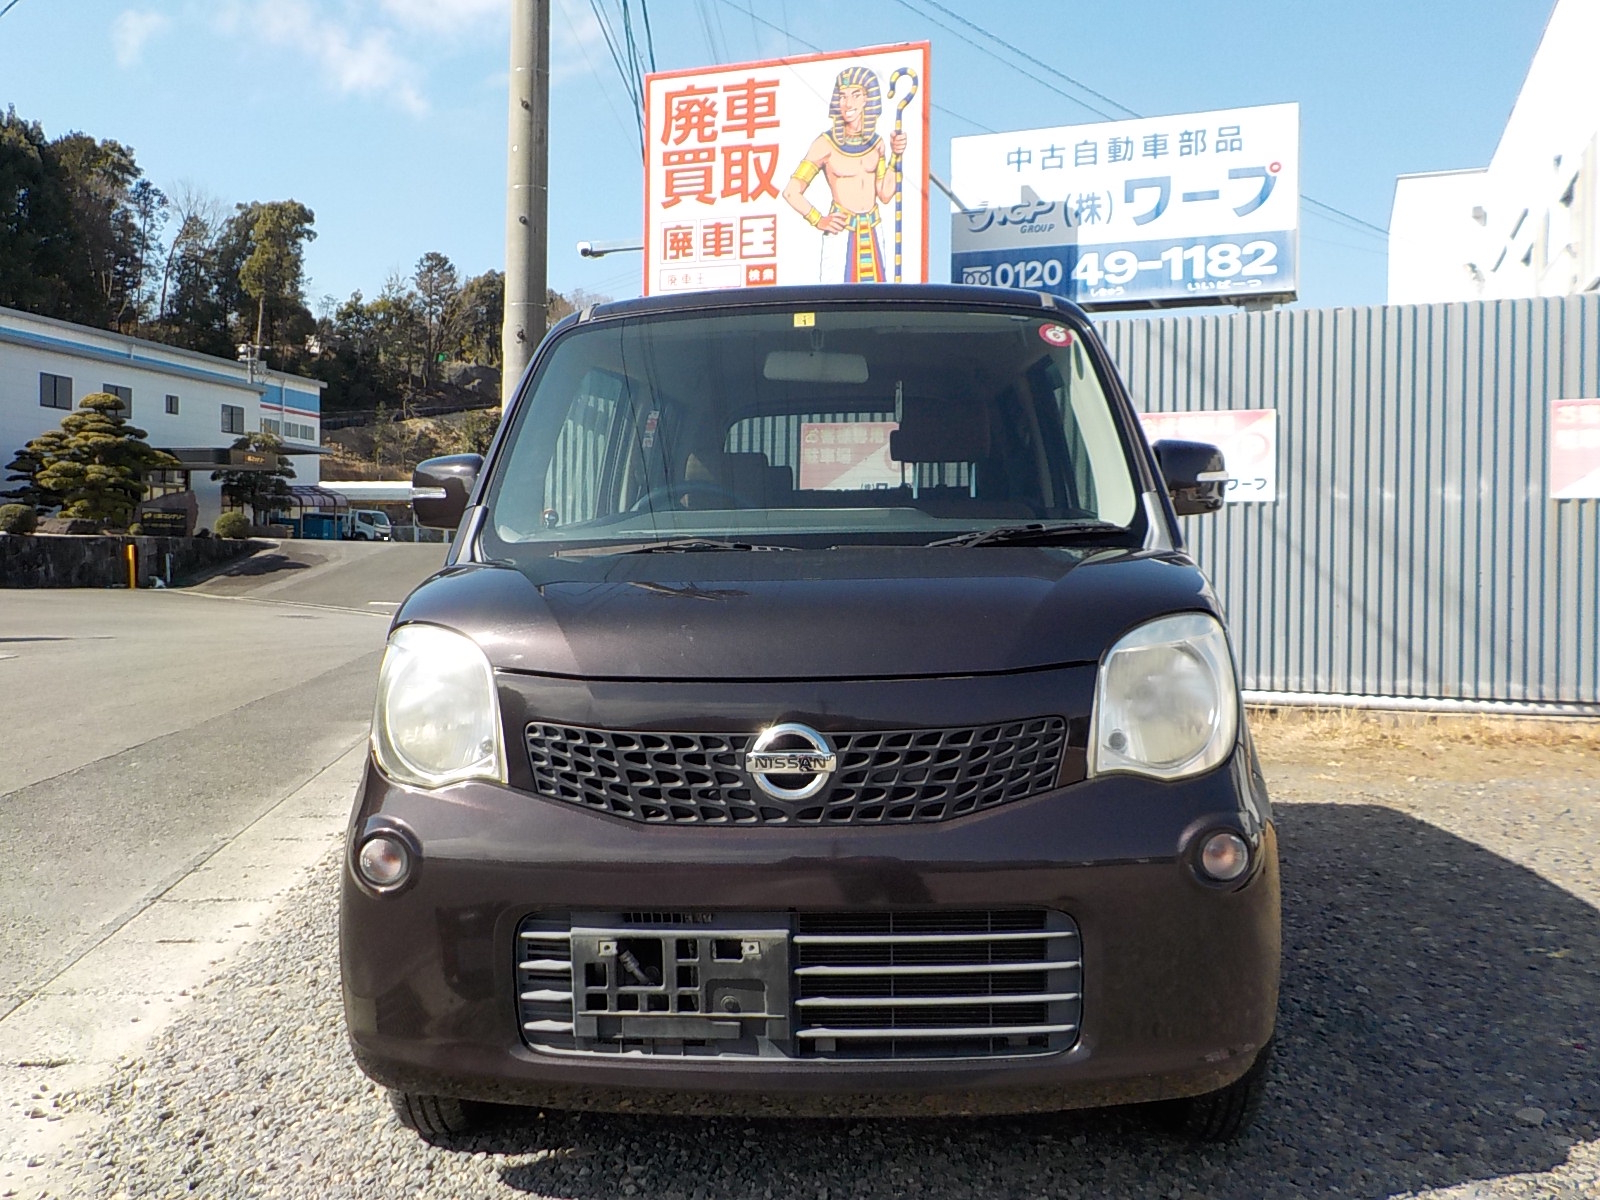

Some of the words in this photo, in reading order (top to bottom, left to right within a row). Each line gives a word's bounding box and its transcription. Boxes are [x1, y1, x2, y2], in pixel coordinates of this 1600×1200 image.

[661, 78, 780, 146] 廃車
[1006, 125, 1243, 173] 中古自動車部品
[661, 143, 780, 209] 買取
[1124, 161, 1282, 227] ワープ
[1020, 223, 1055, 234] GROUP
[995, 260, 1063, 288] 0120
[1071, 240, 1278, 287] 49-1182
[755, 757, 826, 769] NISSAN
